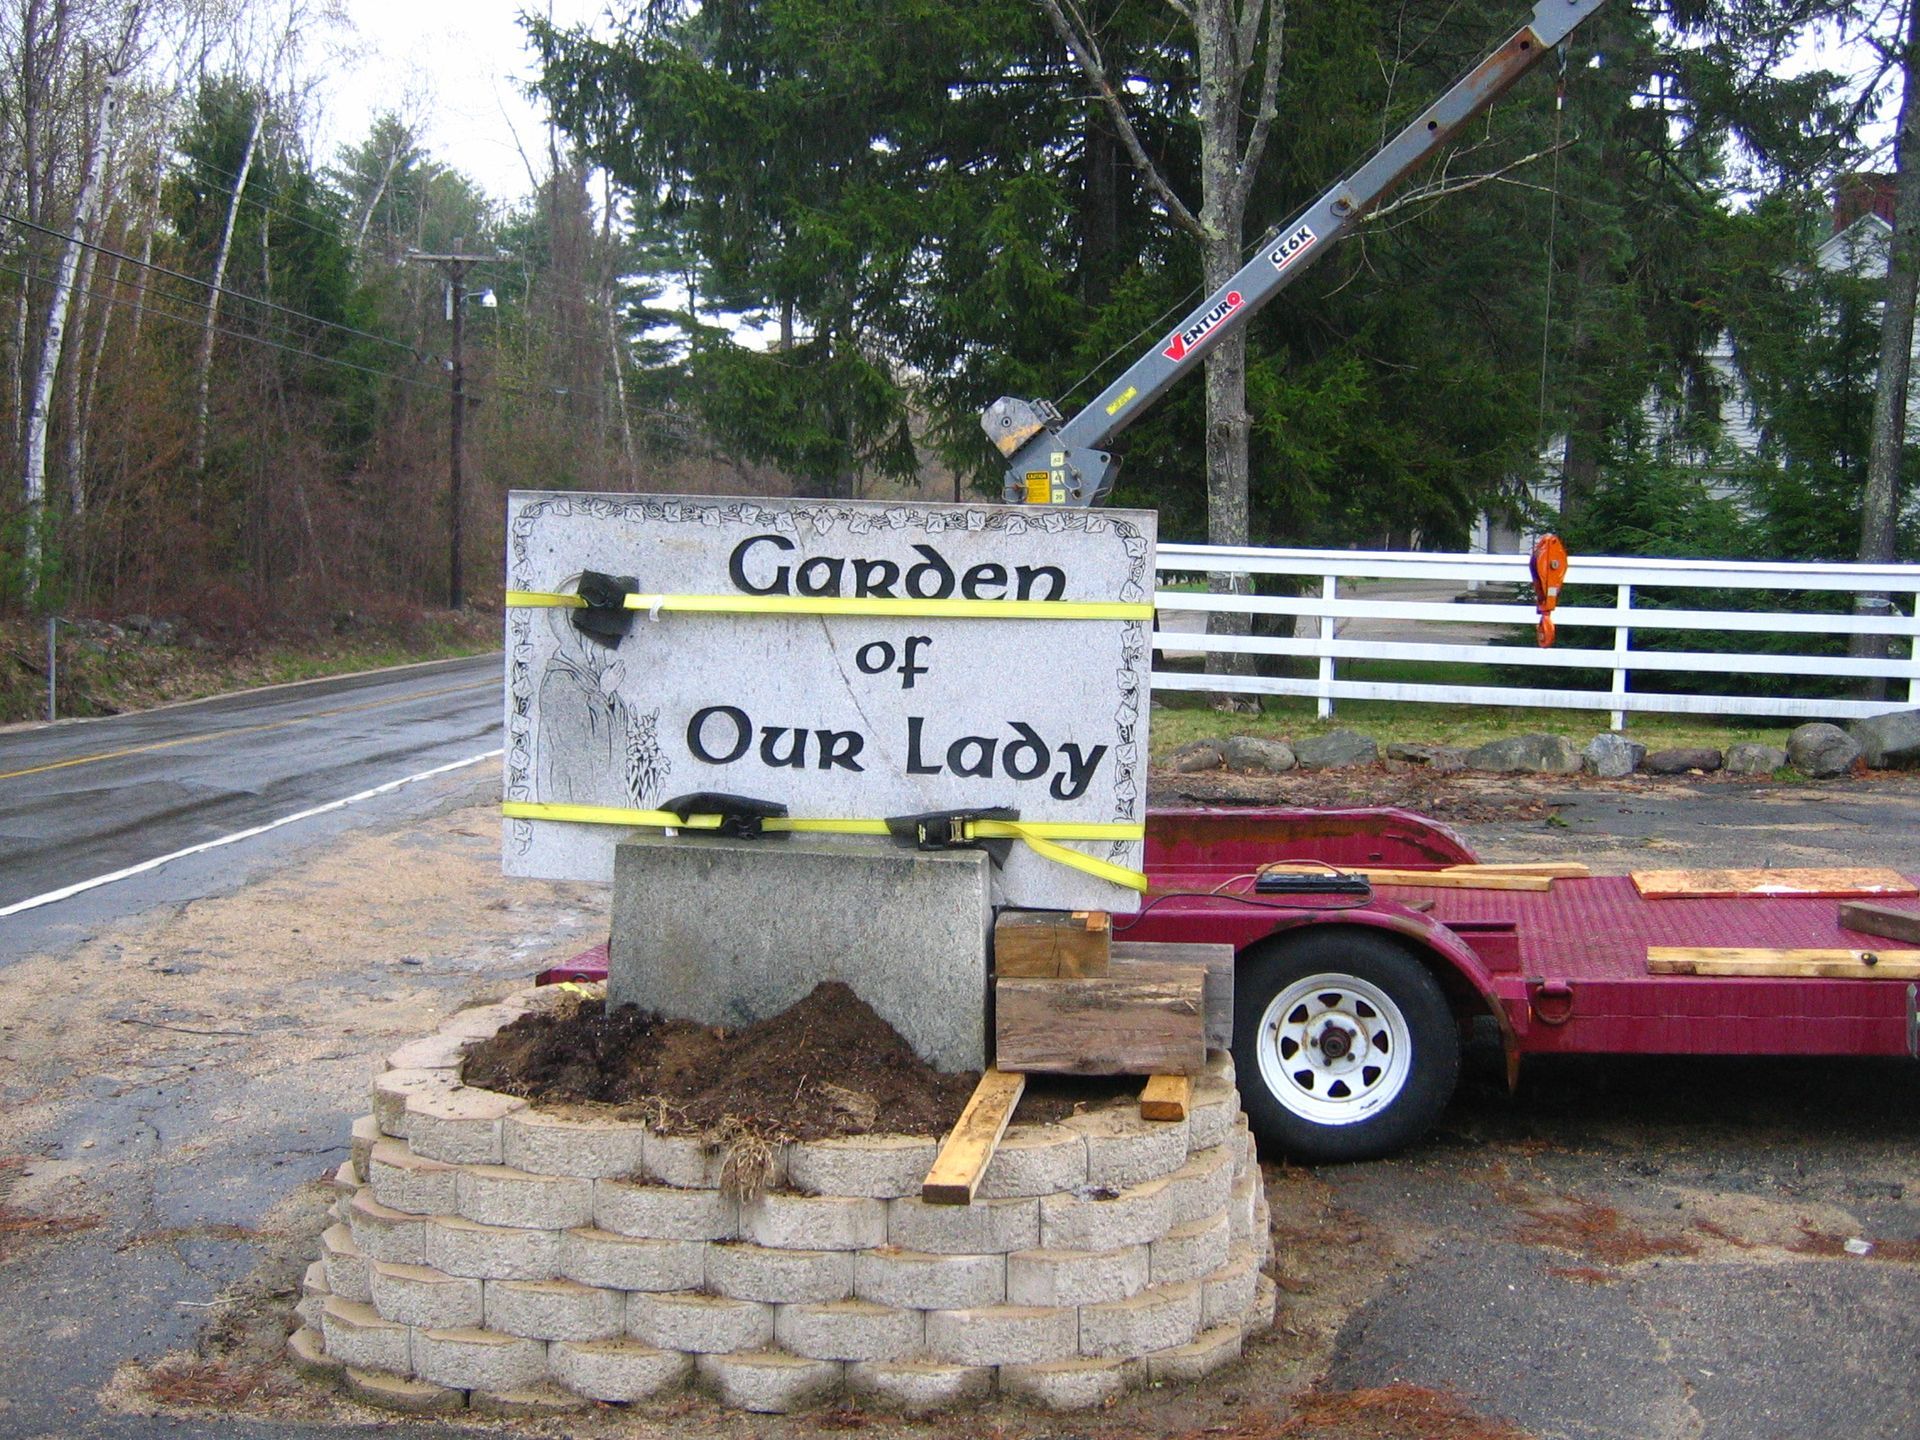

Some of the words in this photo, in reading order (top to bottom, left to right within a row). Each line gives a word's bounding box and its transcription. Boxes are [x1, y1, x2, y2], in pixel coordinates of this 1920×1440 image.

[1271, 227, 1311, 264] CE6K
[1163, 292, 1241, 361] VENTURO
[729, 534, 1068, 601] Garden
[855, 636, 932, 689] of
[686, 705, 864, 772] Our
[906, 717, 1107, 801] Lady
